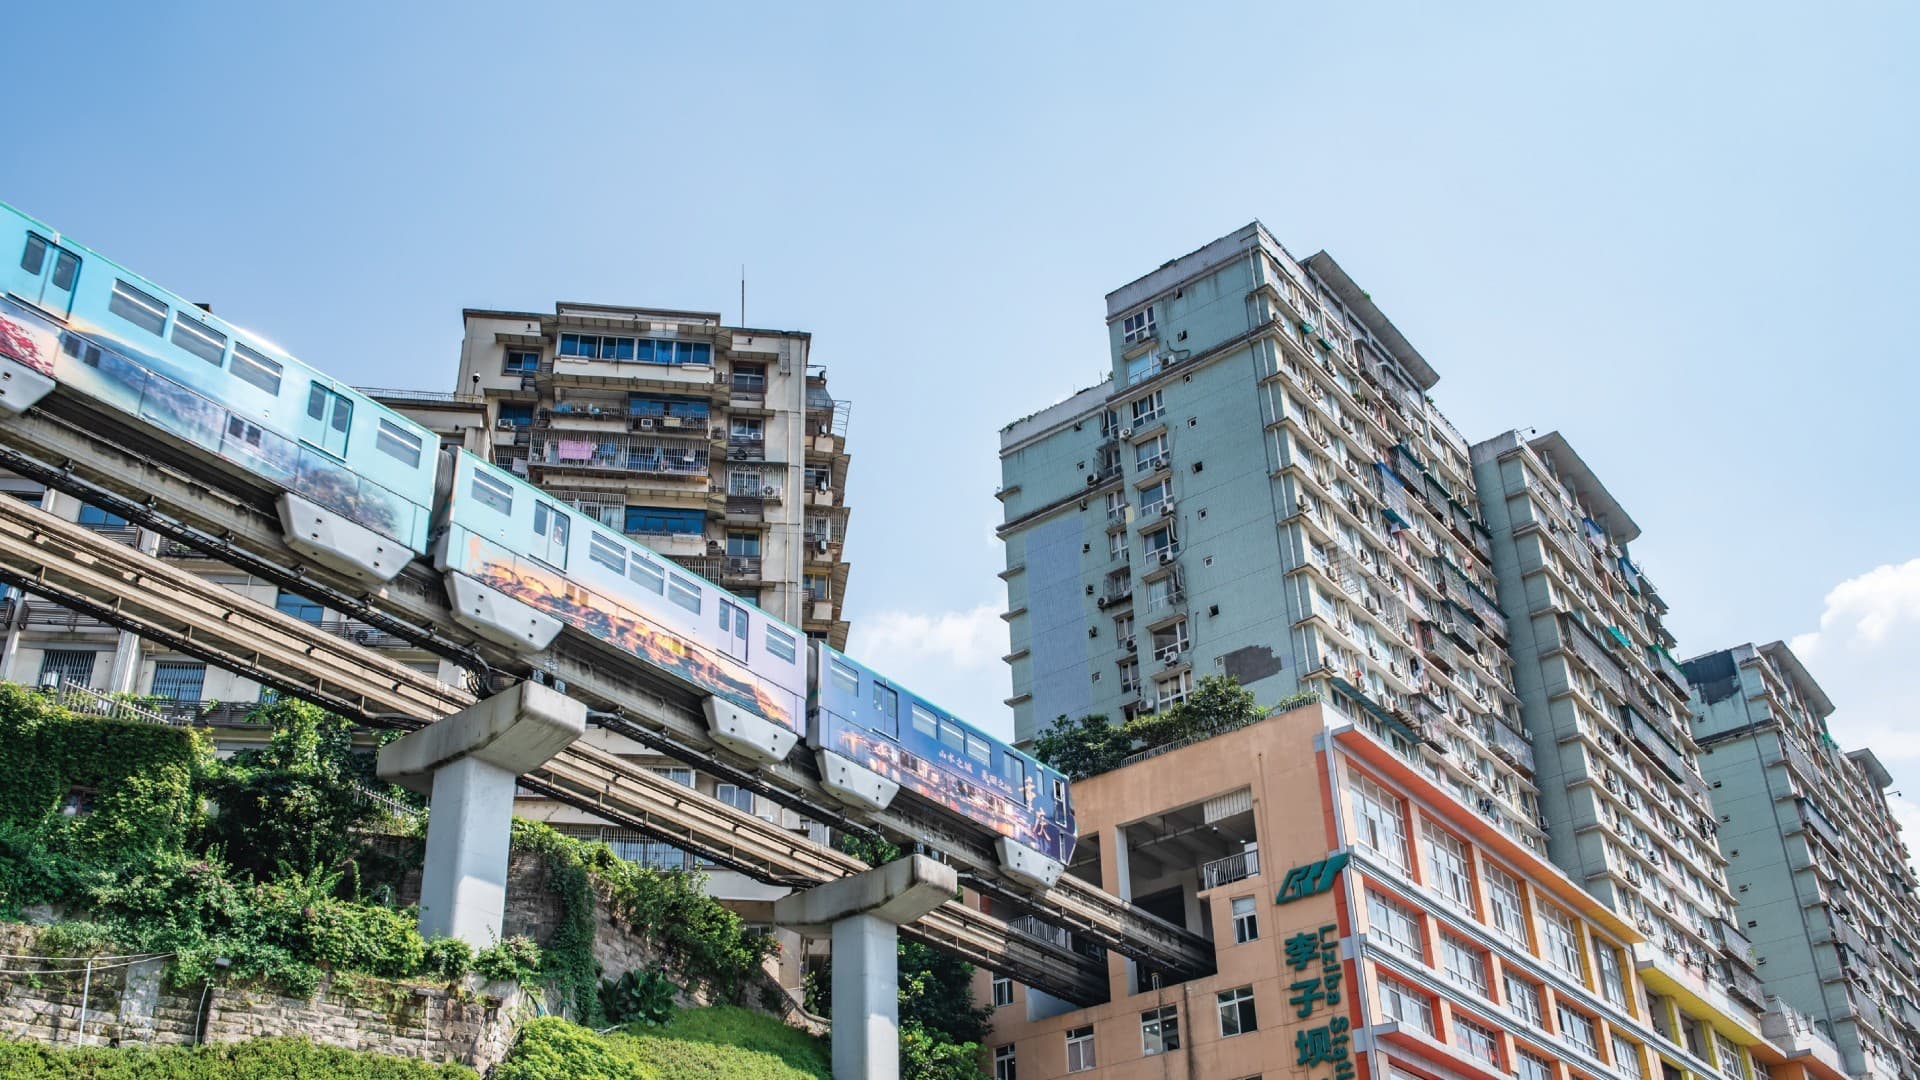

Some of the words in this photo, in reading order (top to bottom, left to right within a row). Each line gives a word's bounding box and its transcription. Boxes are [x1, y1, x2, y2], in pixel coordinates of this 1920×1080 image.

[1018, 776, 1051, 841] 重庆
[1284, 932, 1334, 1080] 李子坝
[1319, 924, 1342, 1006] Liziba
